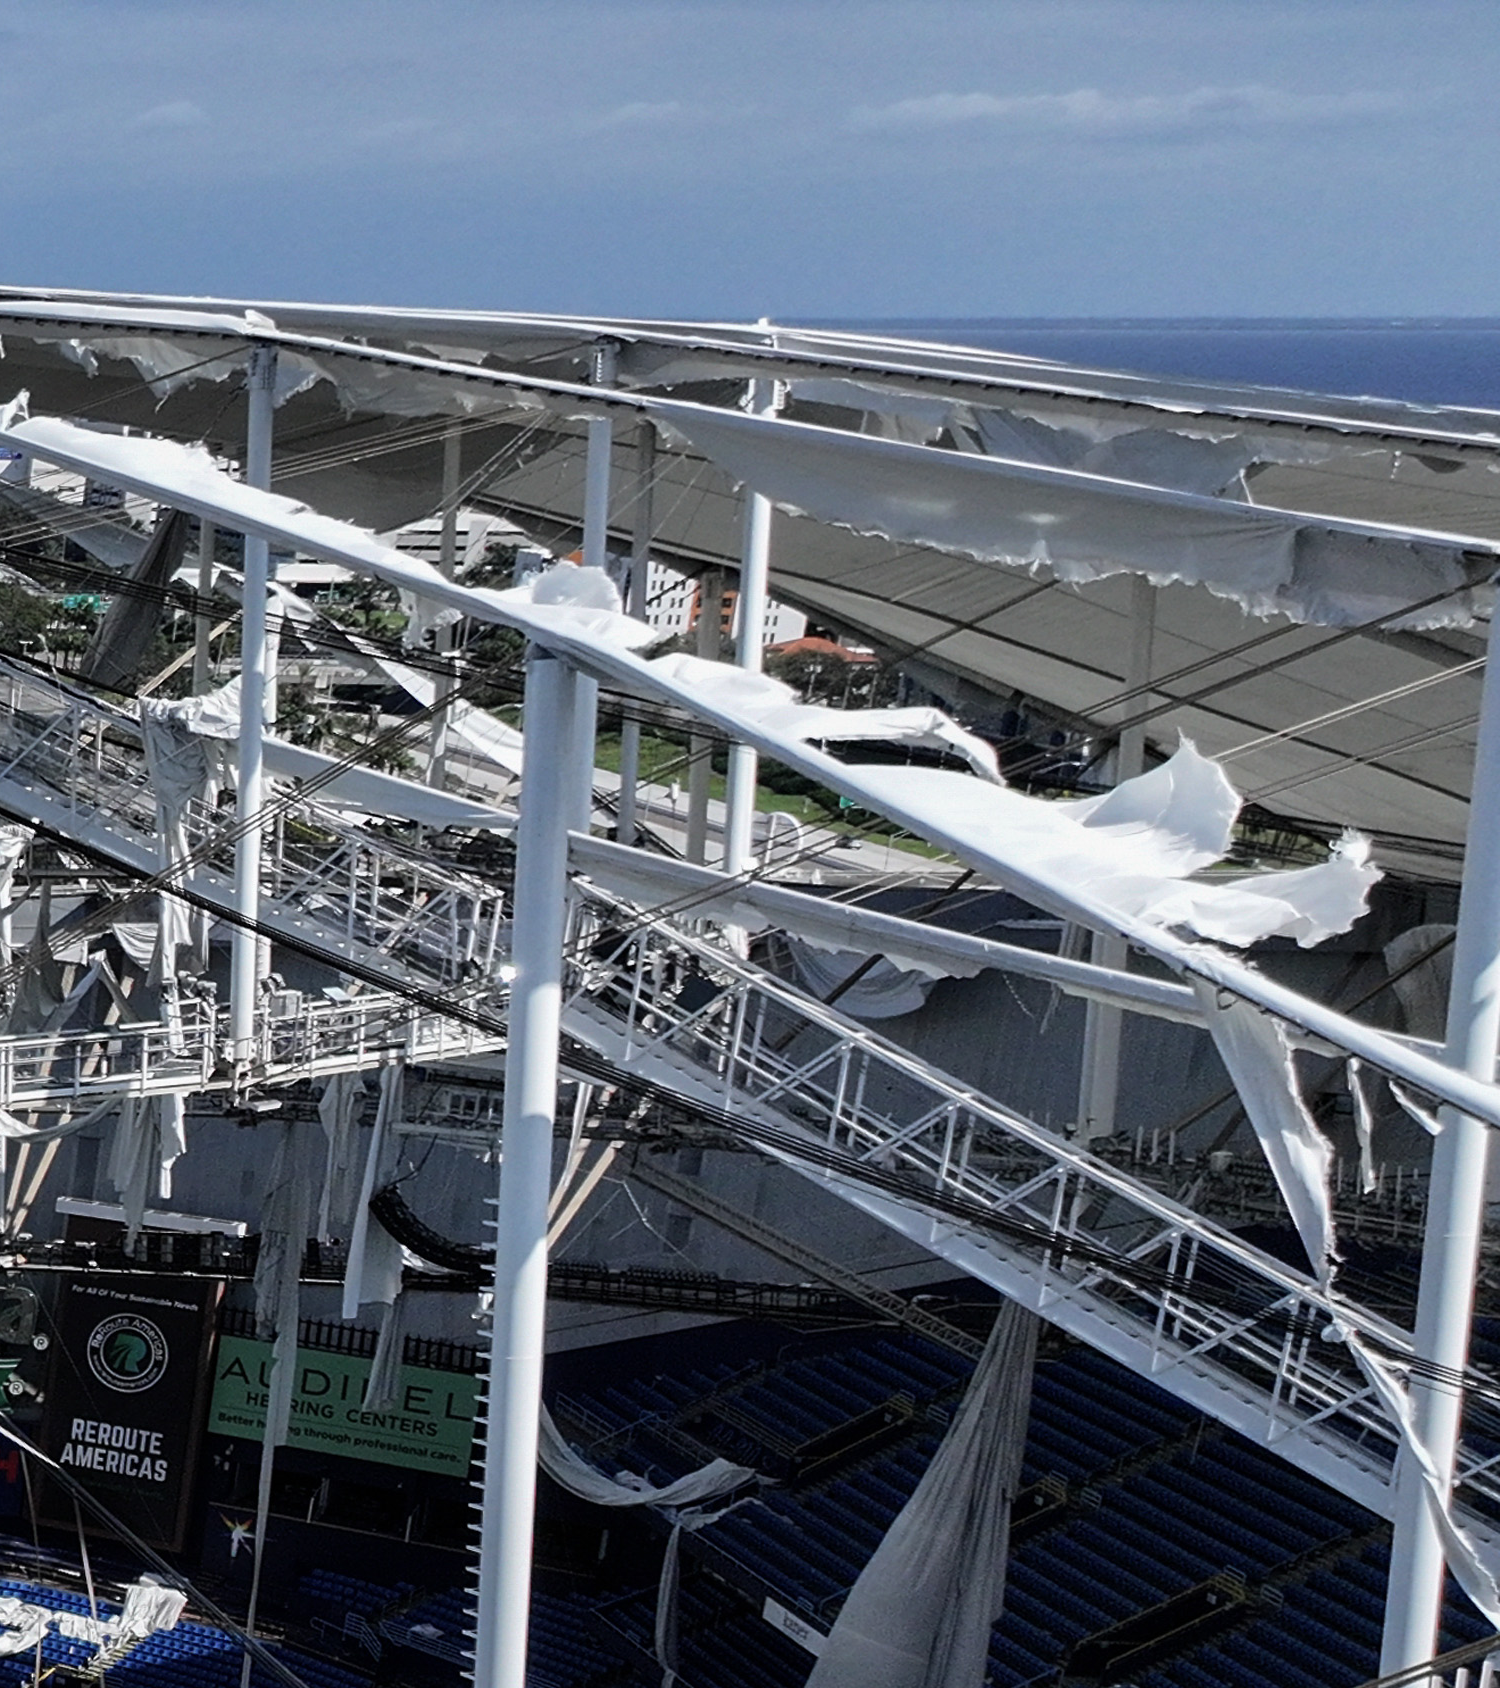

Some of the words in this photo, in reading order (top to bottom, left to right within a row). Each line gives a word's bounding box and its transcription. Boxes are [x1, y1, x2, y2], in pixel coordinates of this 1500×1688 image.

[71, 1417, 164, 1456] REROUTE
[217, 1411, 255, 1428] Better
[303, 1426, 352, 1445] through
[353, 1436, 428, 1458] professional
[345, 1407, 438, 1438] CENTERS
[59, 1442, 168, 1483] AMERICAS
